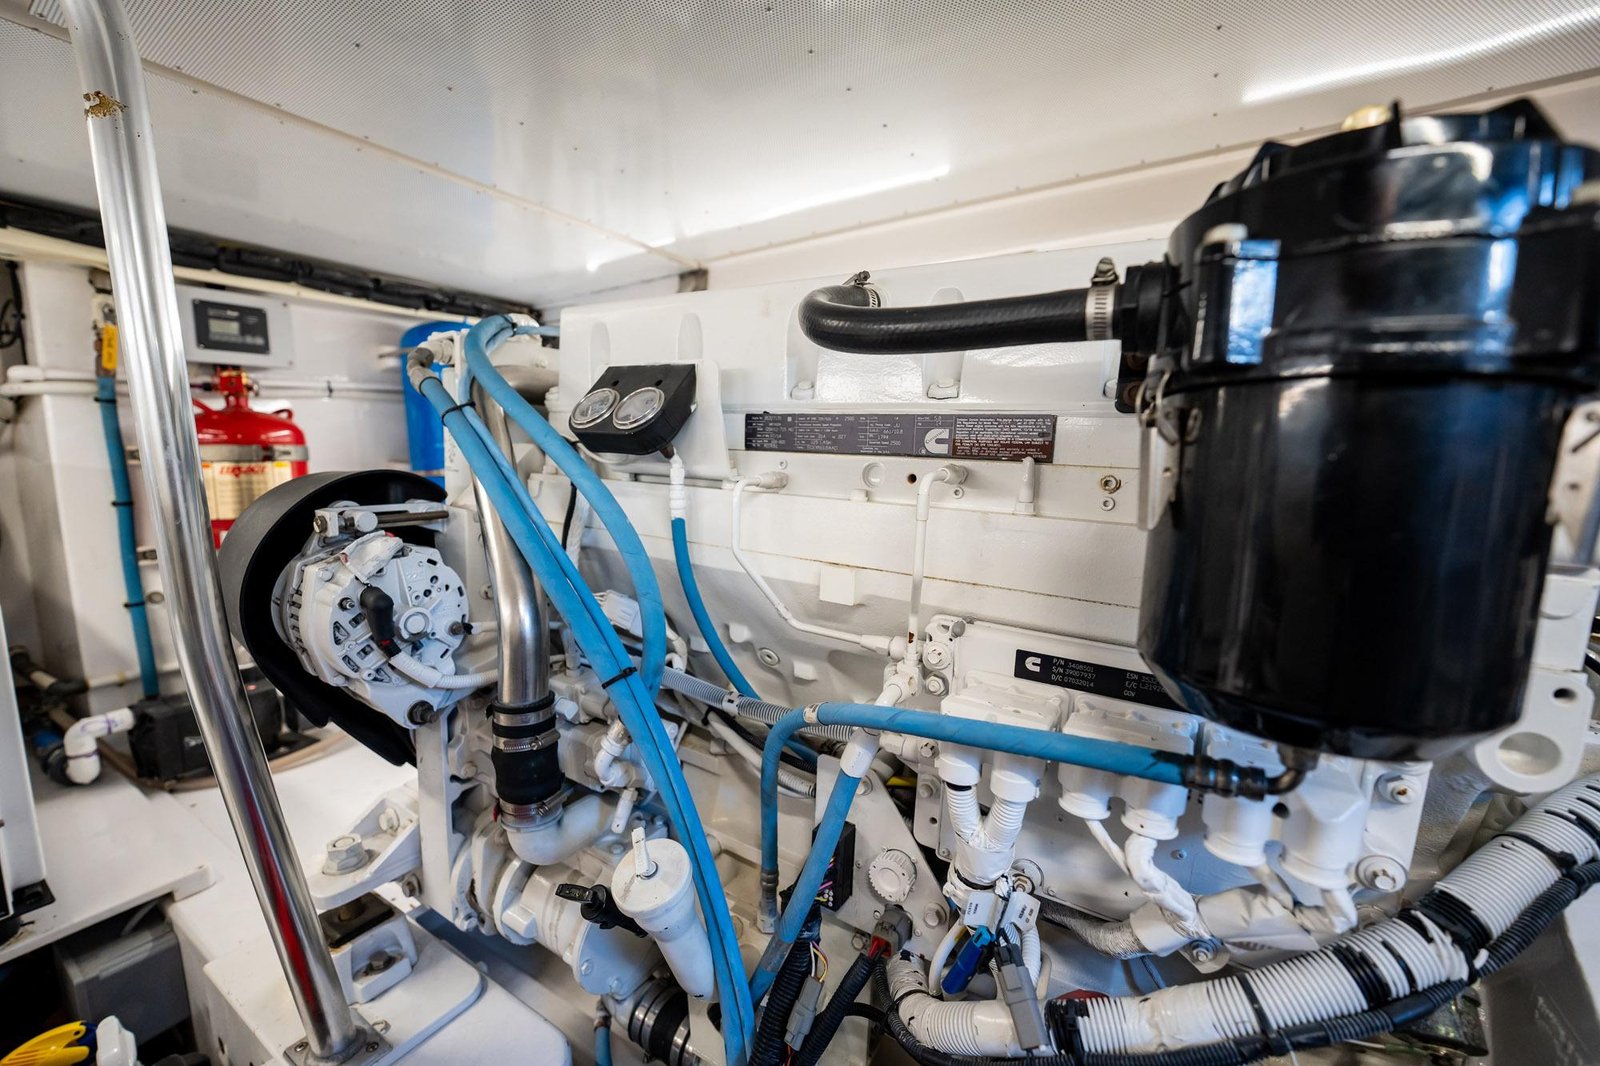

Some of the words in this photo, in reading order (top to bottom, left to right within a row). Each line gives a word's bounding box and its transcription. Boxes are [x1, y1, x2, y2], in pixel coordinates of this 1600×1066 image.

[1052, 658, 1065, 666] P/N
[1052, 665, 1064, 673] S/N
[1051, 673, 1063, 681] D/C
[1063, 676, 1094, 687] 07032014
